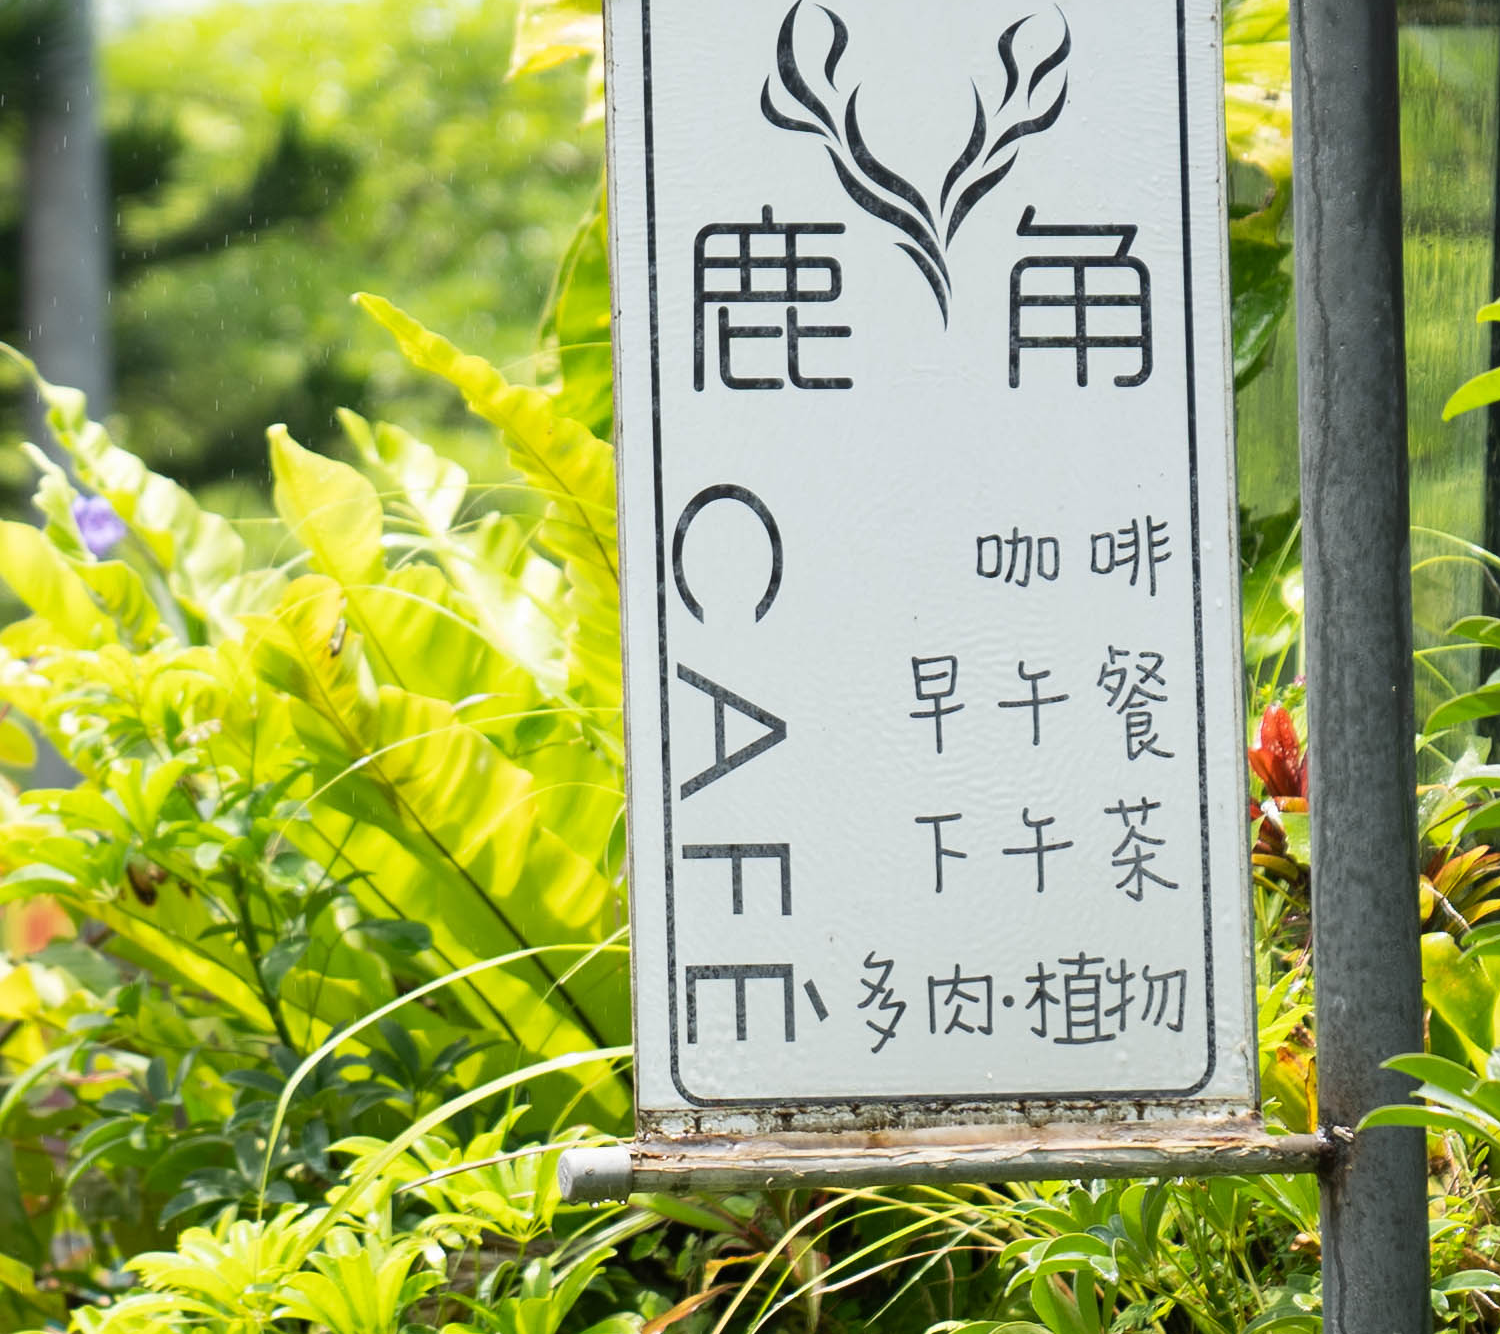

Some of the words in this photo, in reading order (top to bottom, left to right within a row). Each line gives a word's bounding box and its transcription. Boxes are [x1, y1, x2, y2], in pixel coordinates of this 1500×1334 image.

[692, 204, 1155, 395] 鹿角
[976, 515, 1173, 598] 咖啡
[909, 644, 1176, 761] 早午餐
[915, 798, 1180, 903] 下午茶
